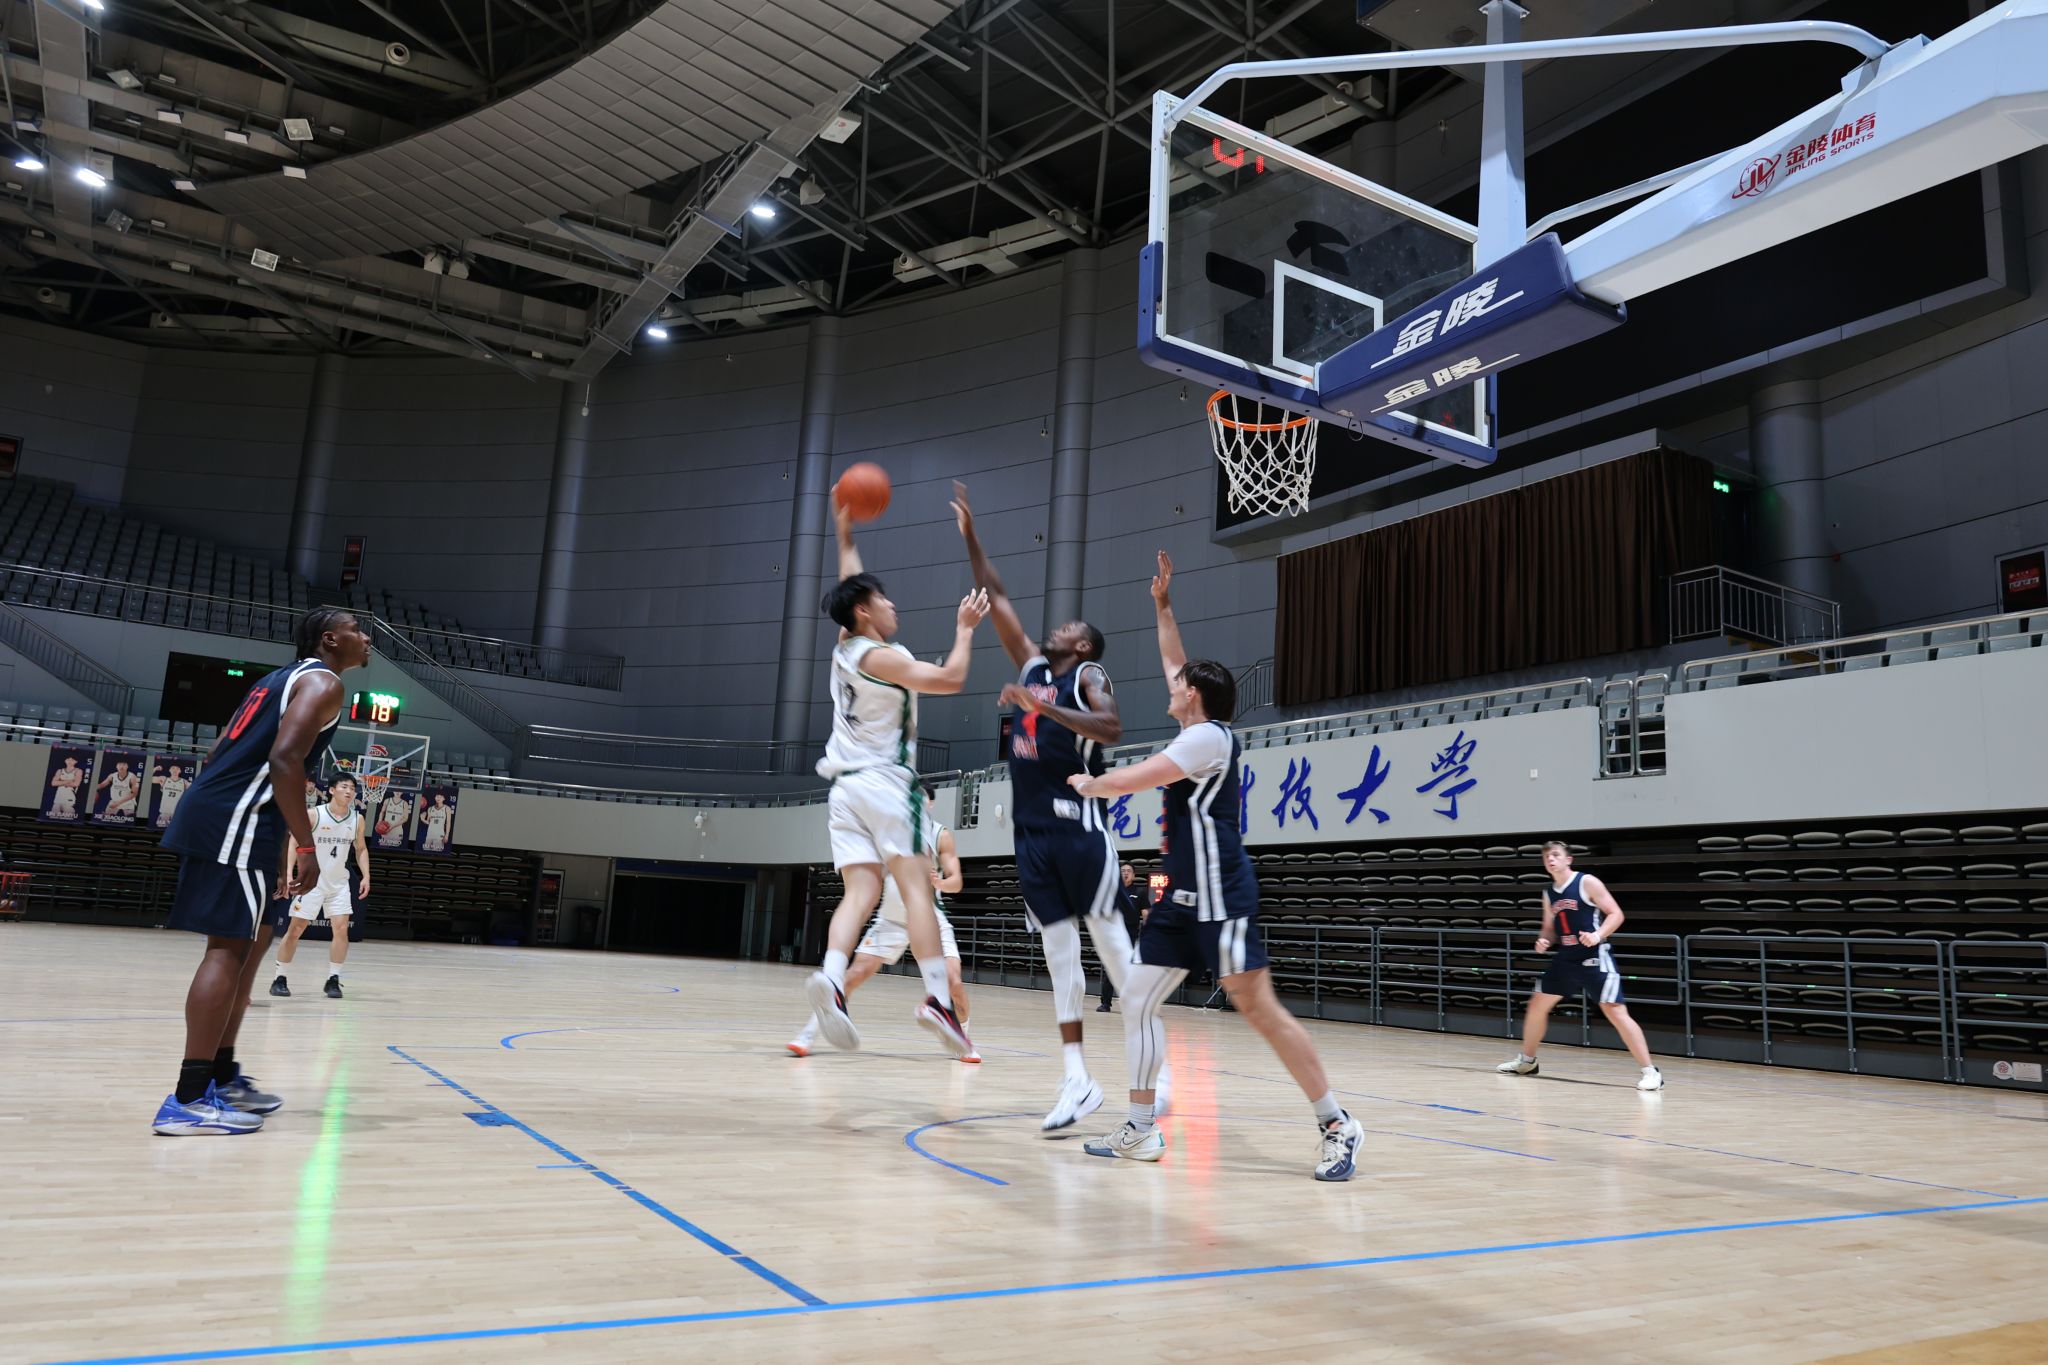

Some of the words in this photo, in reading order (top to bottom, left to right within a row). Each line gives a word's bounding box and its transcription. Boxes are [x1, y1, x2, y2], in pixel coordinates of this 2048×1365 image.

[1785, 112, 1877, 168] 金陵体育
[1785, 154, 1827, 177] JINLING
[1830, 131, 1875, 156] SPORTS
[1386, 277, 1510, 358] 金陵
[1380, 356, 1494, 408] 金陵
[371, 704, 391, 722] 18
[184, 766, 194, 774] 23
[329, 845, 338, 859] 4
